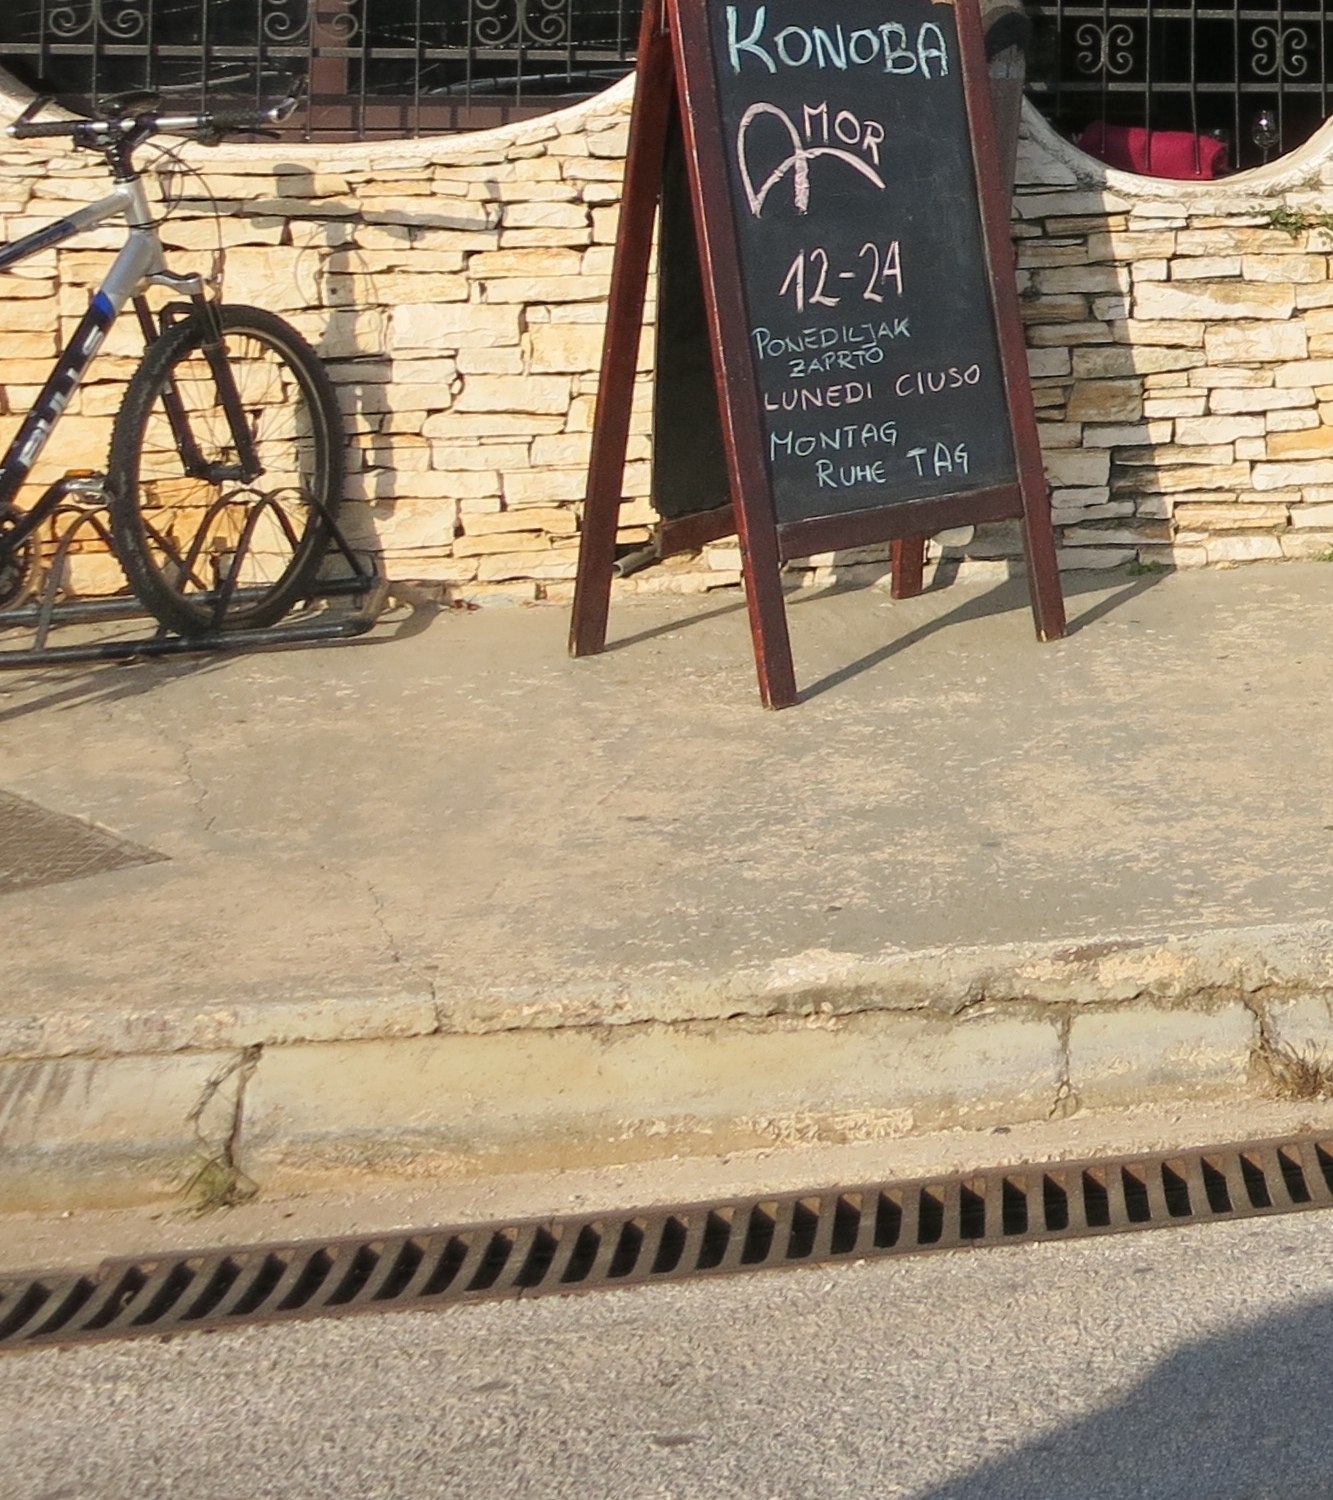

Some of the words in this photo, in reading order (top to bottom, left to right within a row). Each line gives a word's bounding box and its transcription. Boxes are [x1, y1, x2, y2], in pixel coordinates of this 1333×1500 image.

[726, 5, 949, 79] KONOBA
[737, 101, 887, 219] AMOR
[778, 240, 905, 312] 12-24
[788, 347, 885, 377] ZAPRTO
[764, 382, 873, 411] LUNEDI
[895, 364, 981, 397] CIUSO
[769, 421, 899, 461] MONTAG
[815, 459, 887, 488] RUHE
[906, 442, 970, 477] TAG
